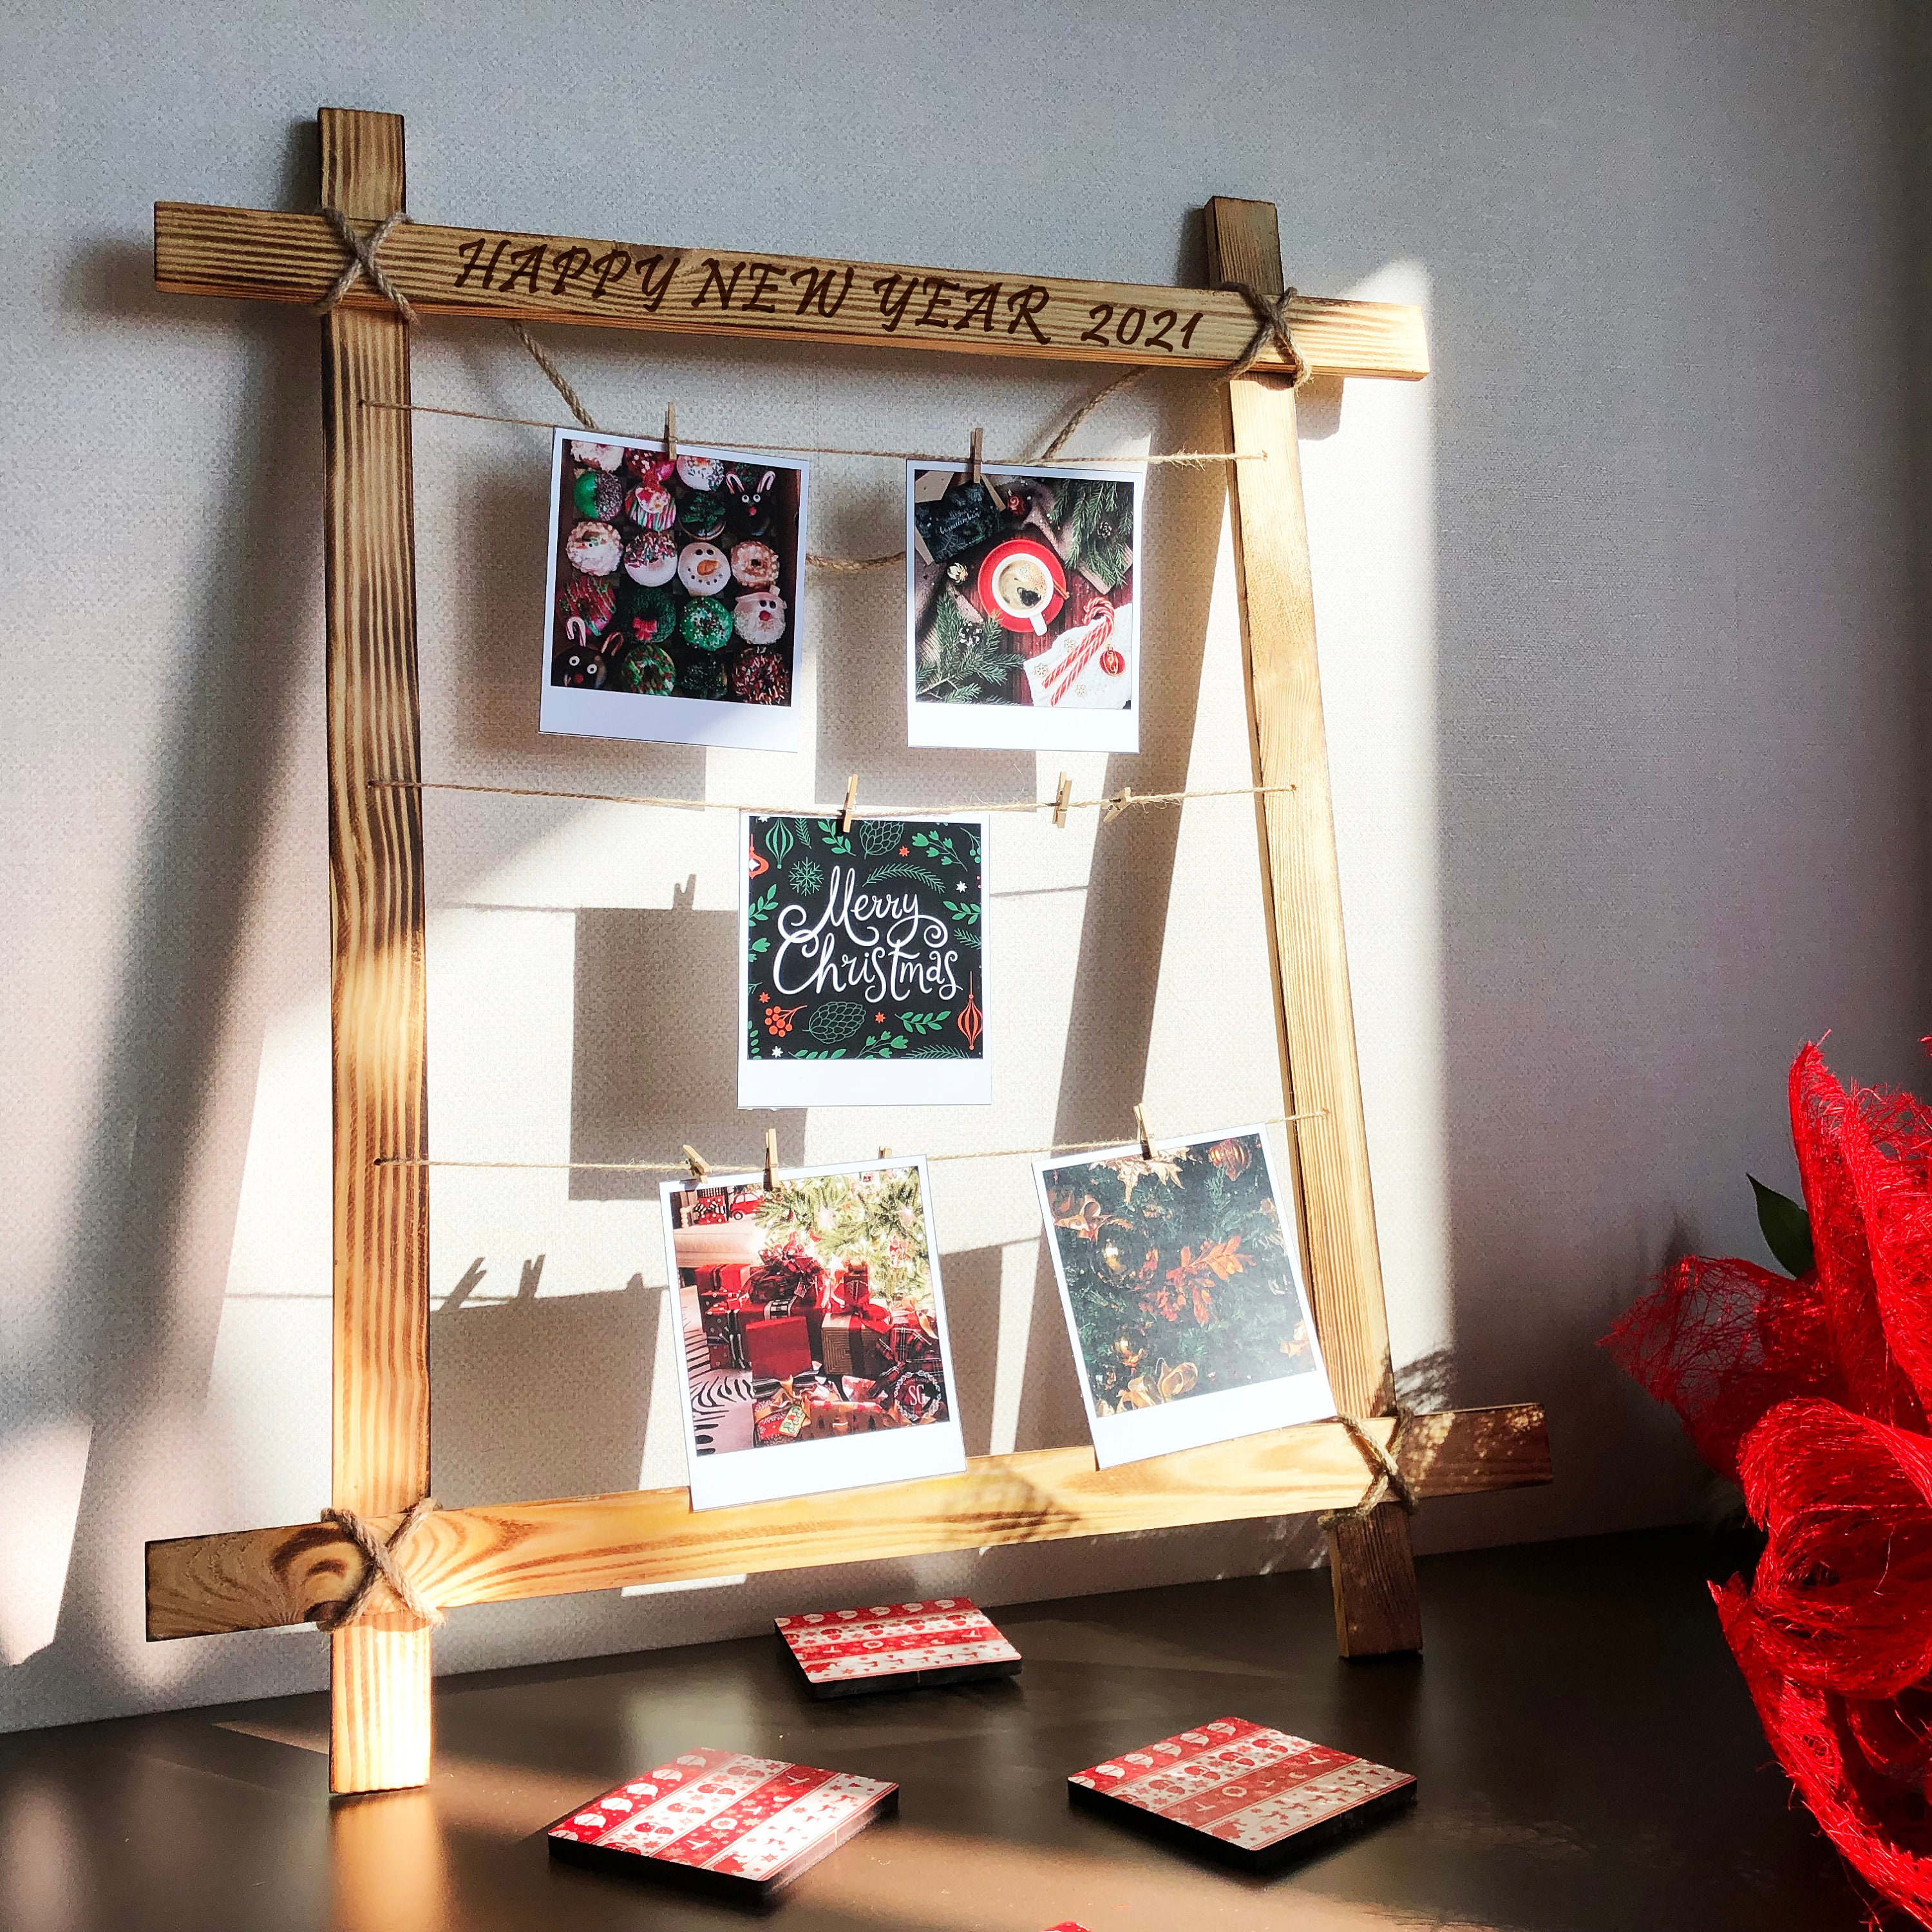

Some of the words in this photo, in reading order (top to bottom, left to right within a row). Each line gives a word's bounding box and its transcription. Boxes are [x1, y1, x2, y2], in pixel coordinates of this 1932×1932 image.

[454, 238, 681, 312] HAPPY
[691, 258, 855, 319] NEW
[873, 273, 1052, 345] YEAR
[1080, 304, 1204, 352] 2021
[777, 865, 949, 949] Merry
[773, 929, 963, 1003] Christmas
